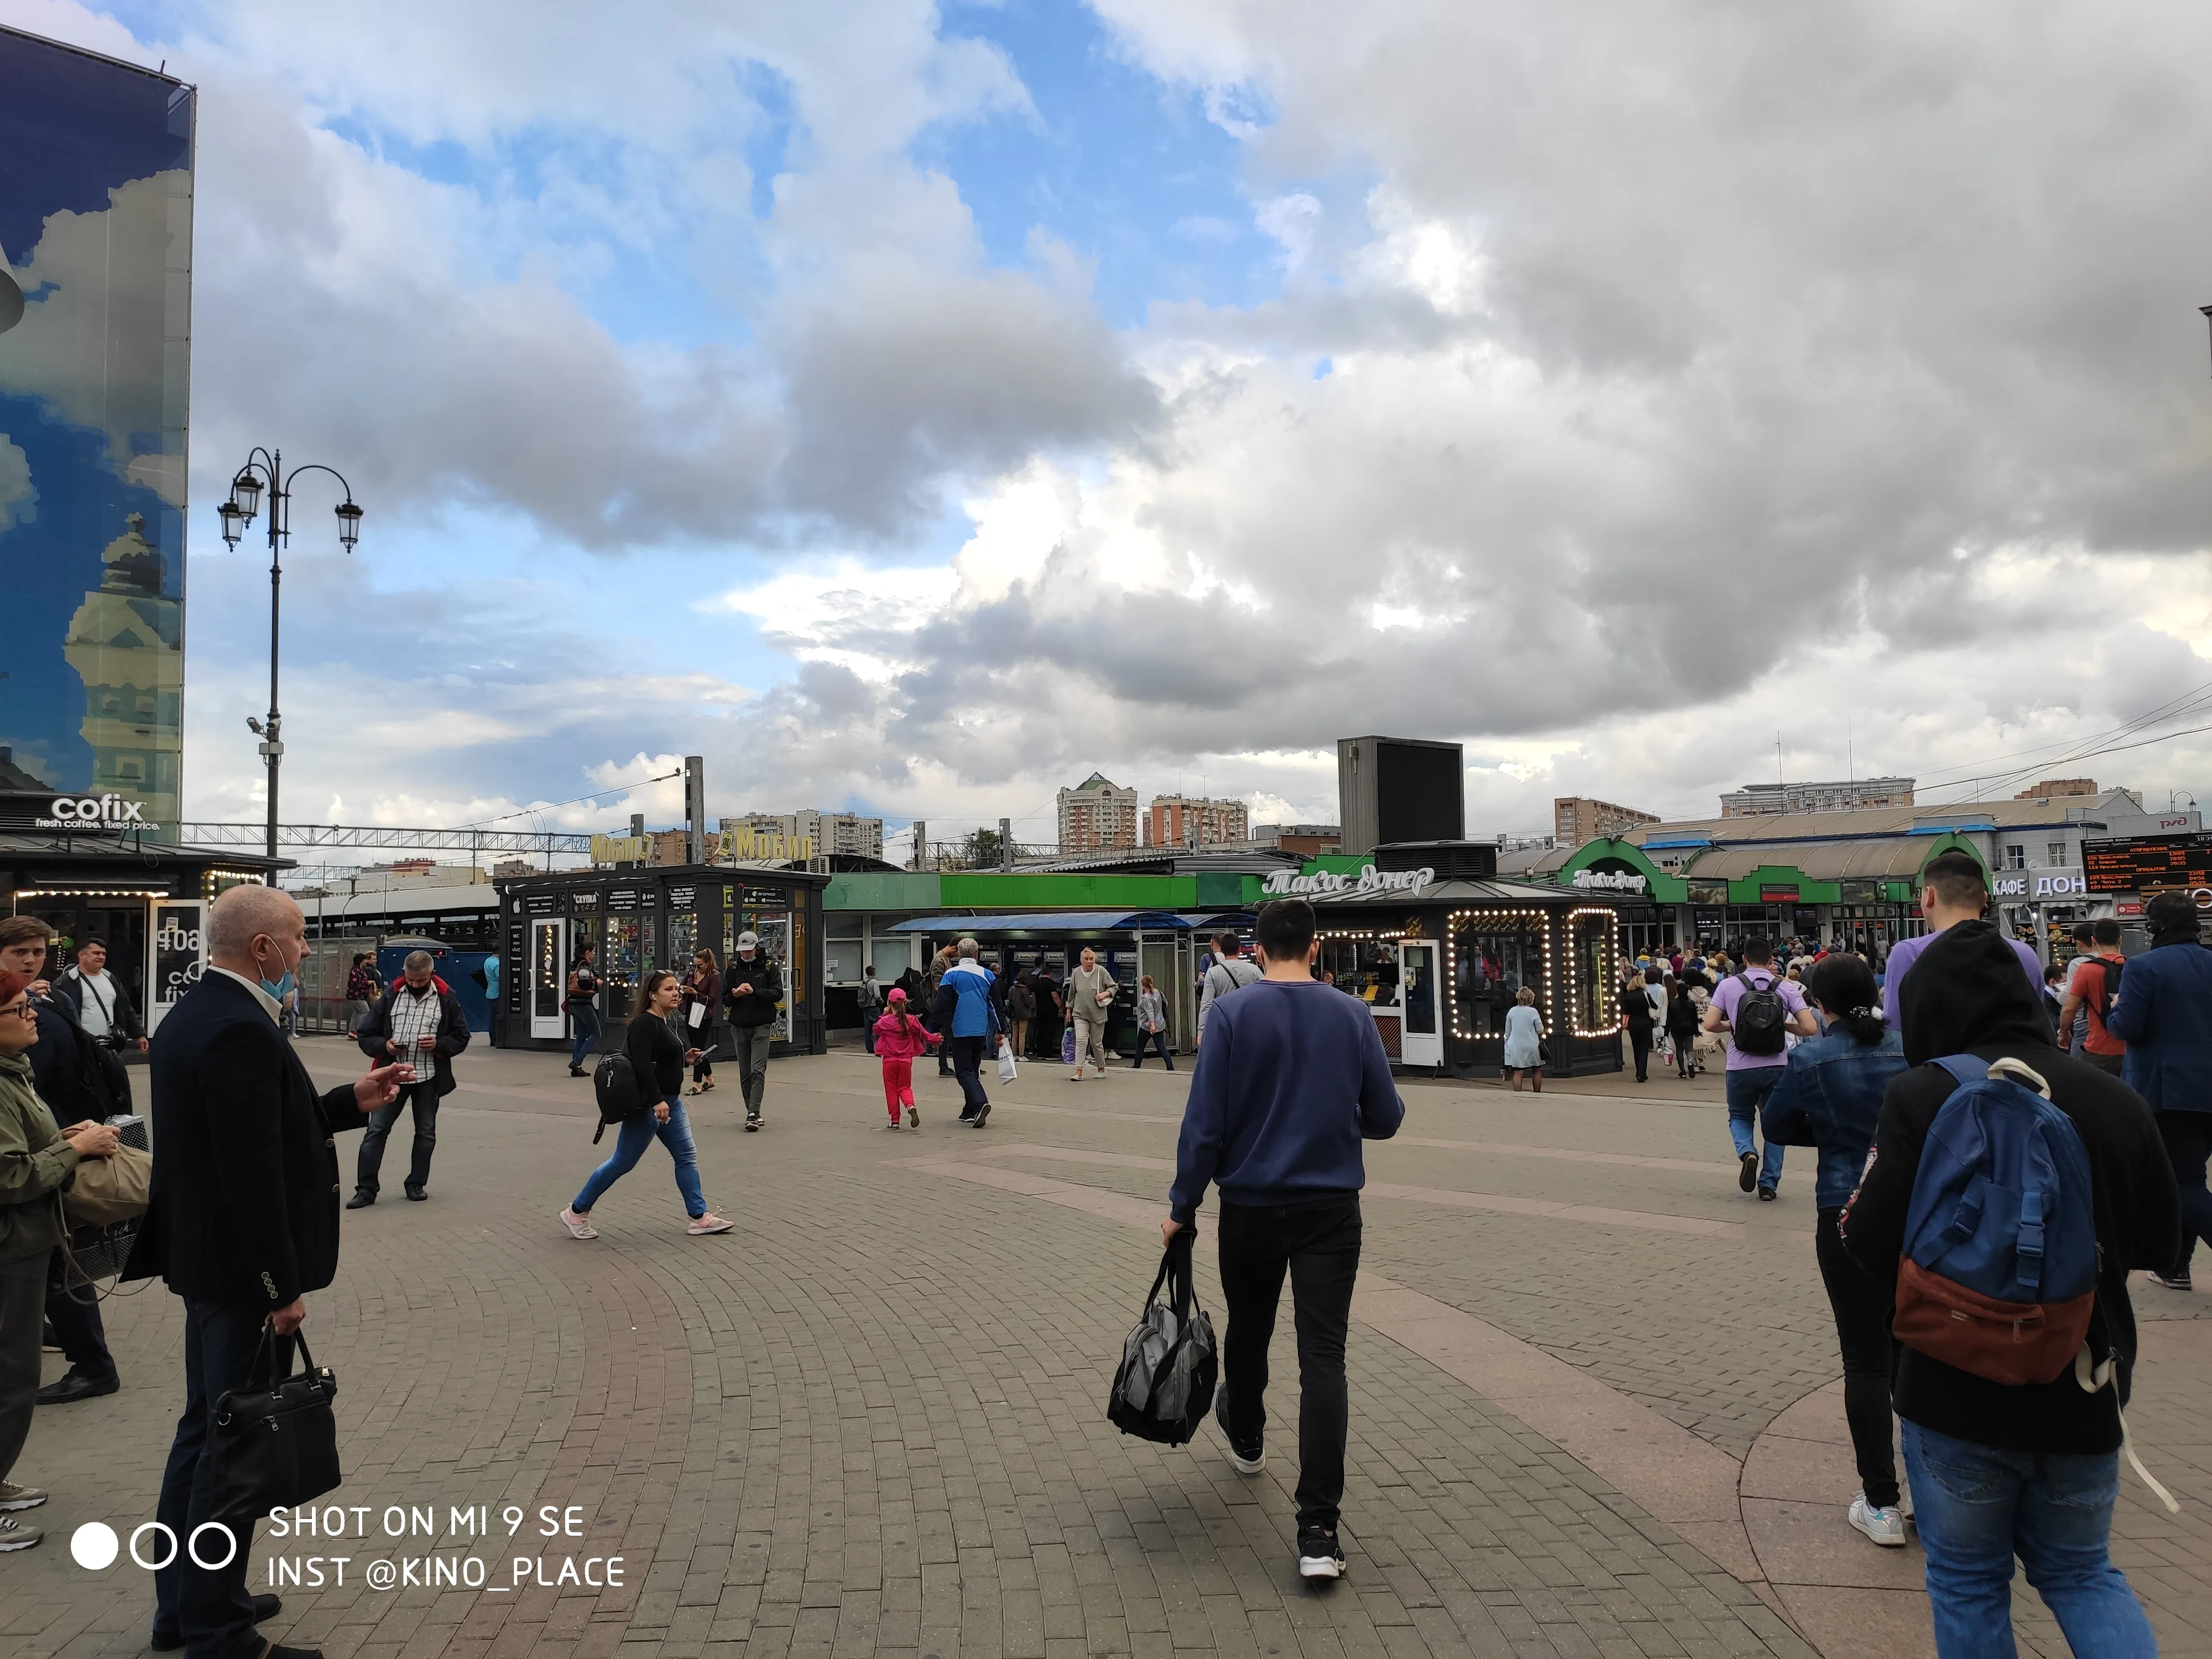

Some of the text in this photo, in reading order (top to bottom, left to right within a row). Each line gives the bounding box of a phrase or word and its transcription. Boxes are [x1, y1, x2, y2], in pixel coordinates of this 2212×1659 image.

[52, 794, 147, 821] cofix
[35, 818, 61, 828] fresh
[104, 820, 129, 829] fixed
[1262, 869, 1352, 894] Такос
[1992, 879, 2027, 896] КАФЕ
[575, 894, 597, 904] СКУПКА
